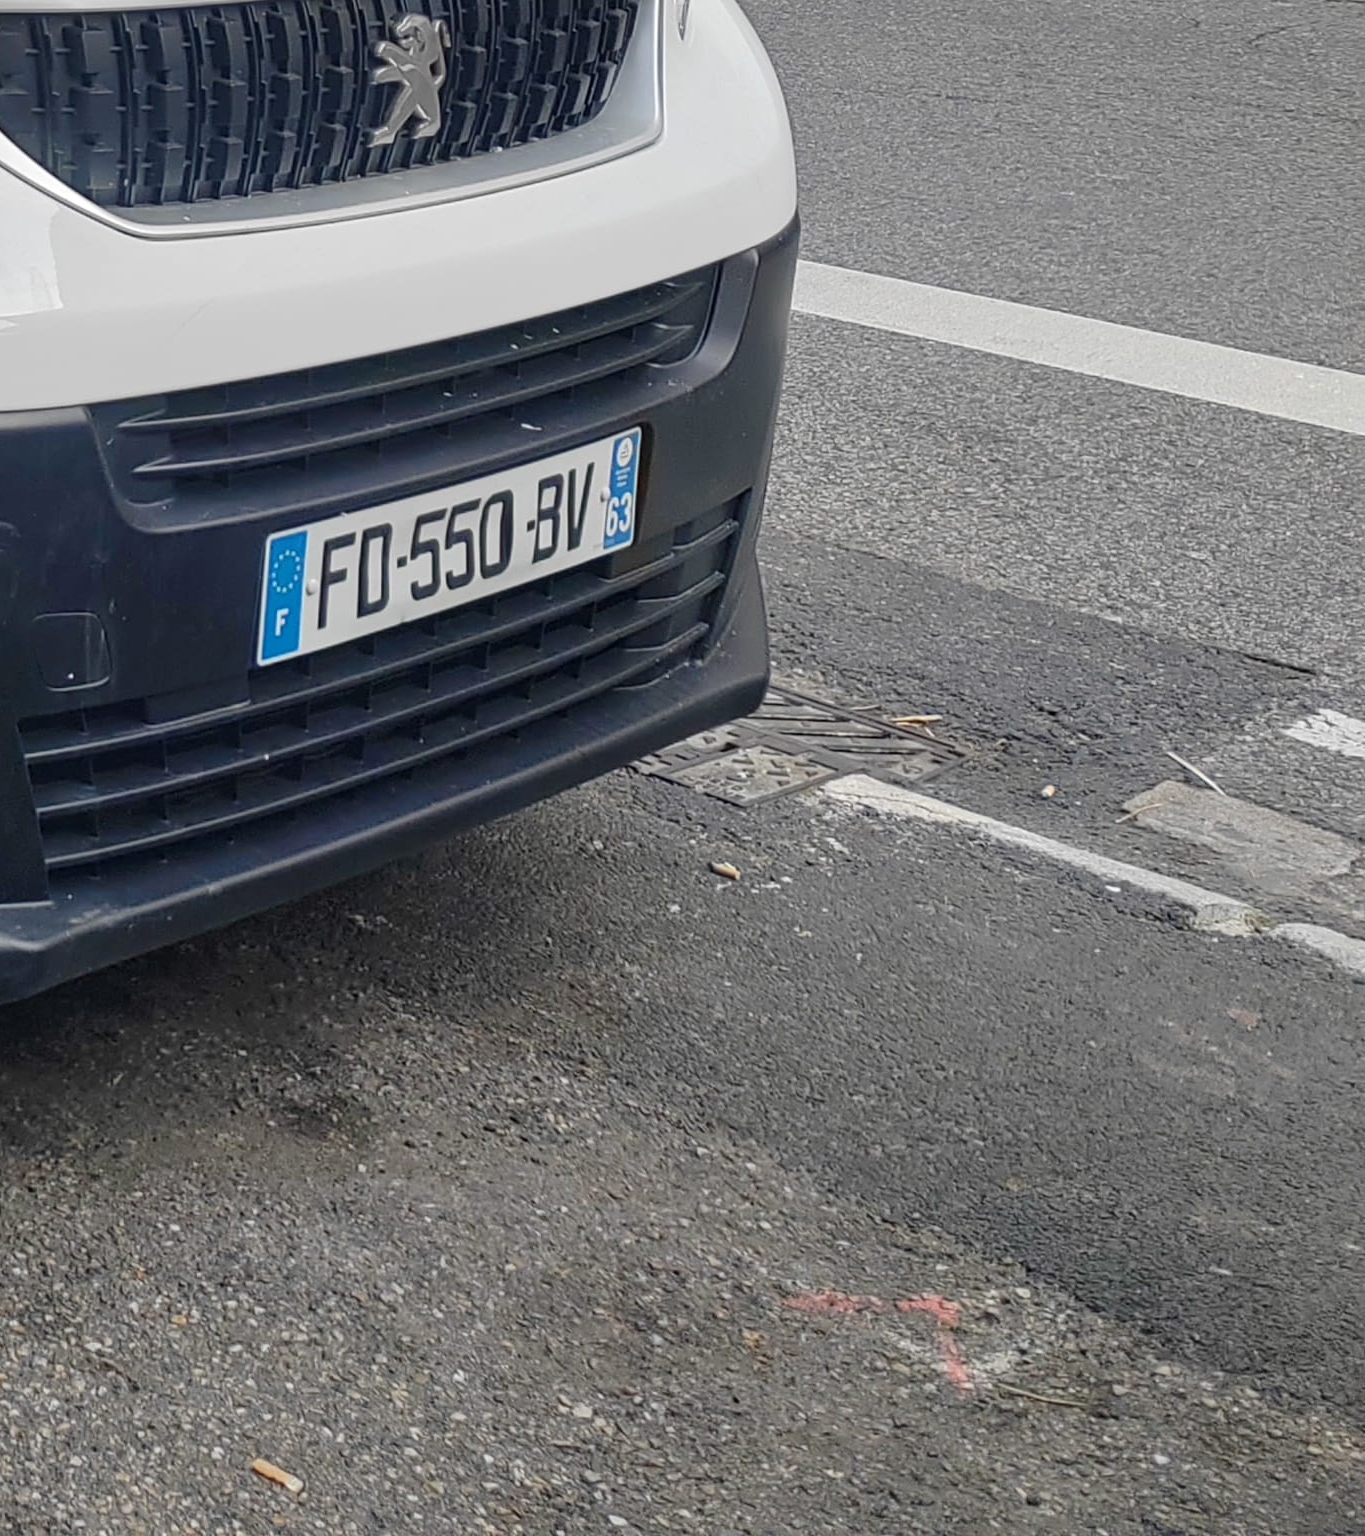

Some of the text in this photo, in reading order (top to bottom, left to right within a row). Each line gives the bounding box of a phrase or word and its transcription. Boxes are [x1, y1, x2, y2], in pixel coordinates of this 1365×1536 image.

[606, 492, 633, 537] 63
[317, 462, 595, 630] FD-550-BV
[275, 607, 289, 636] F
